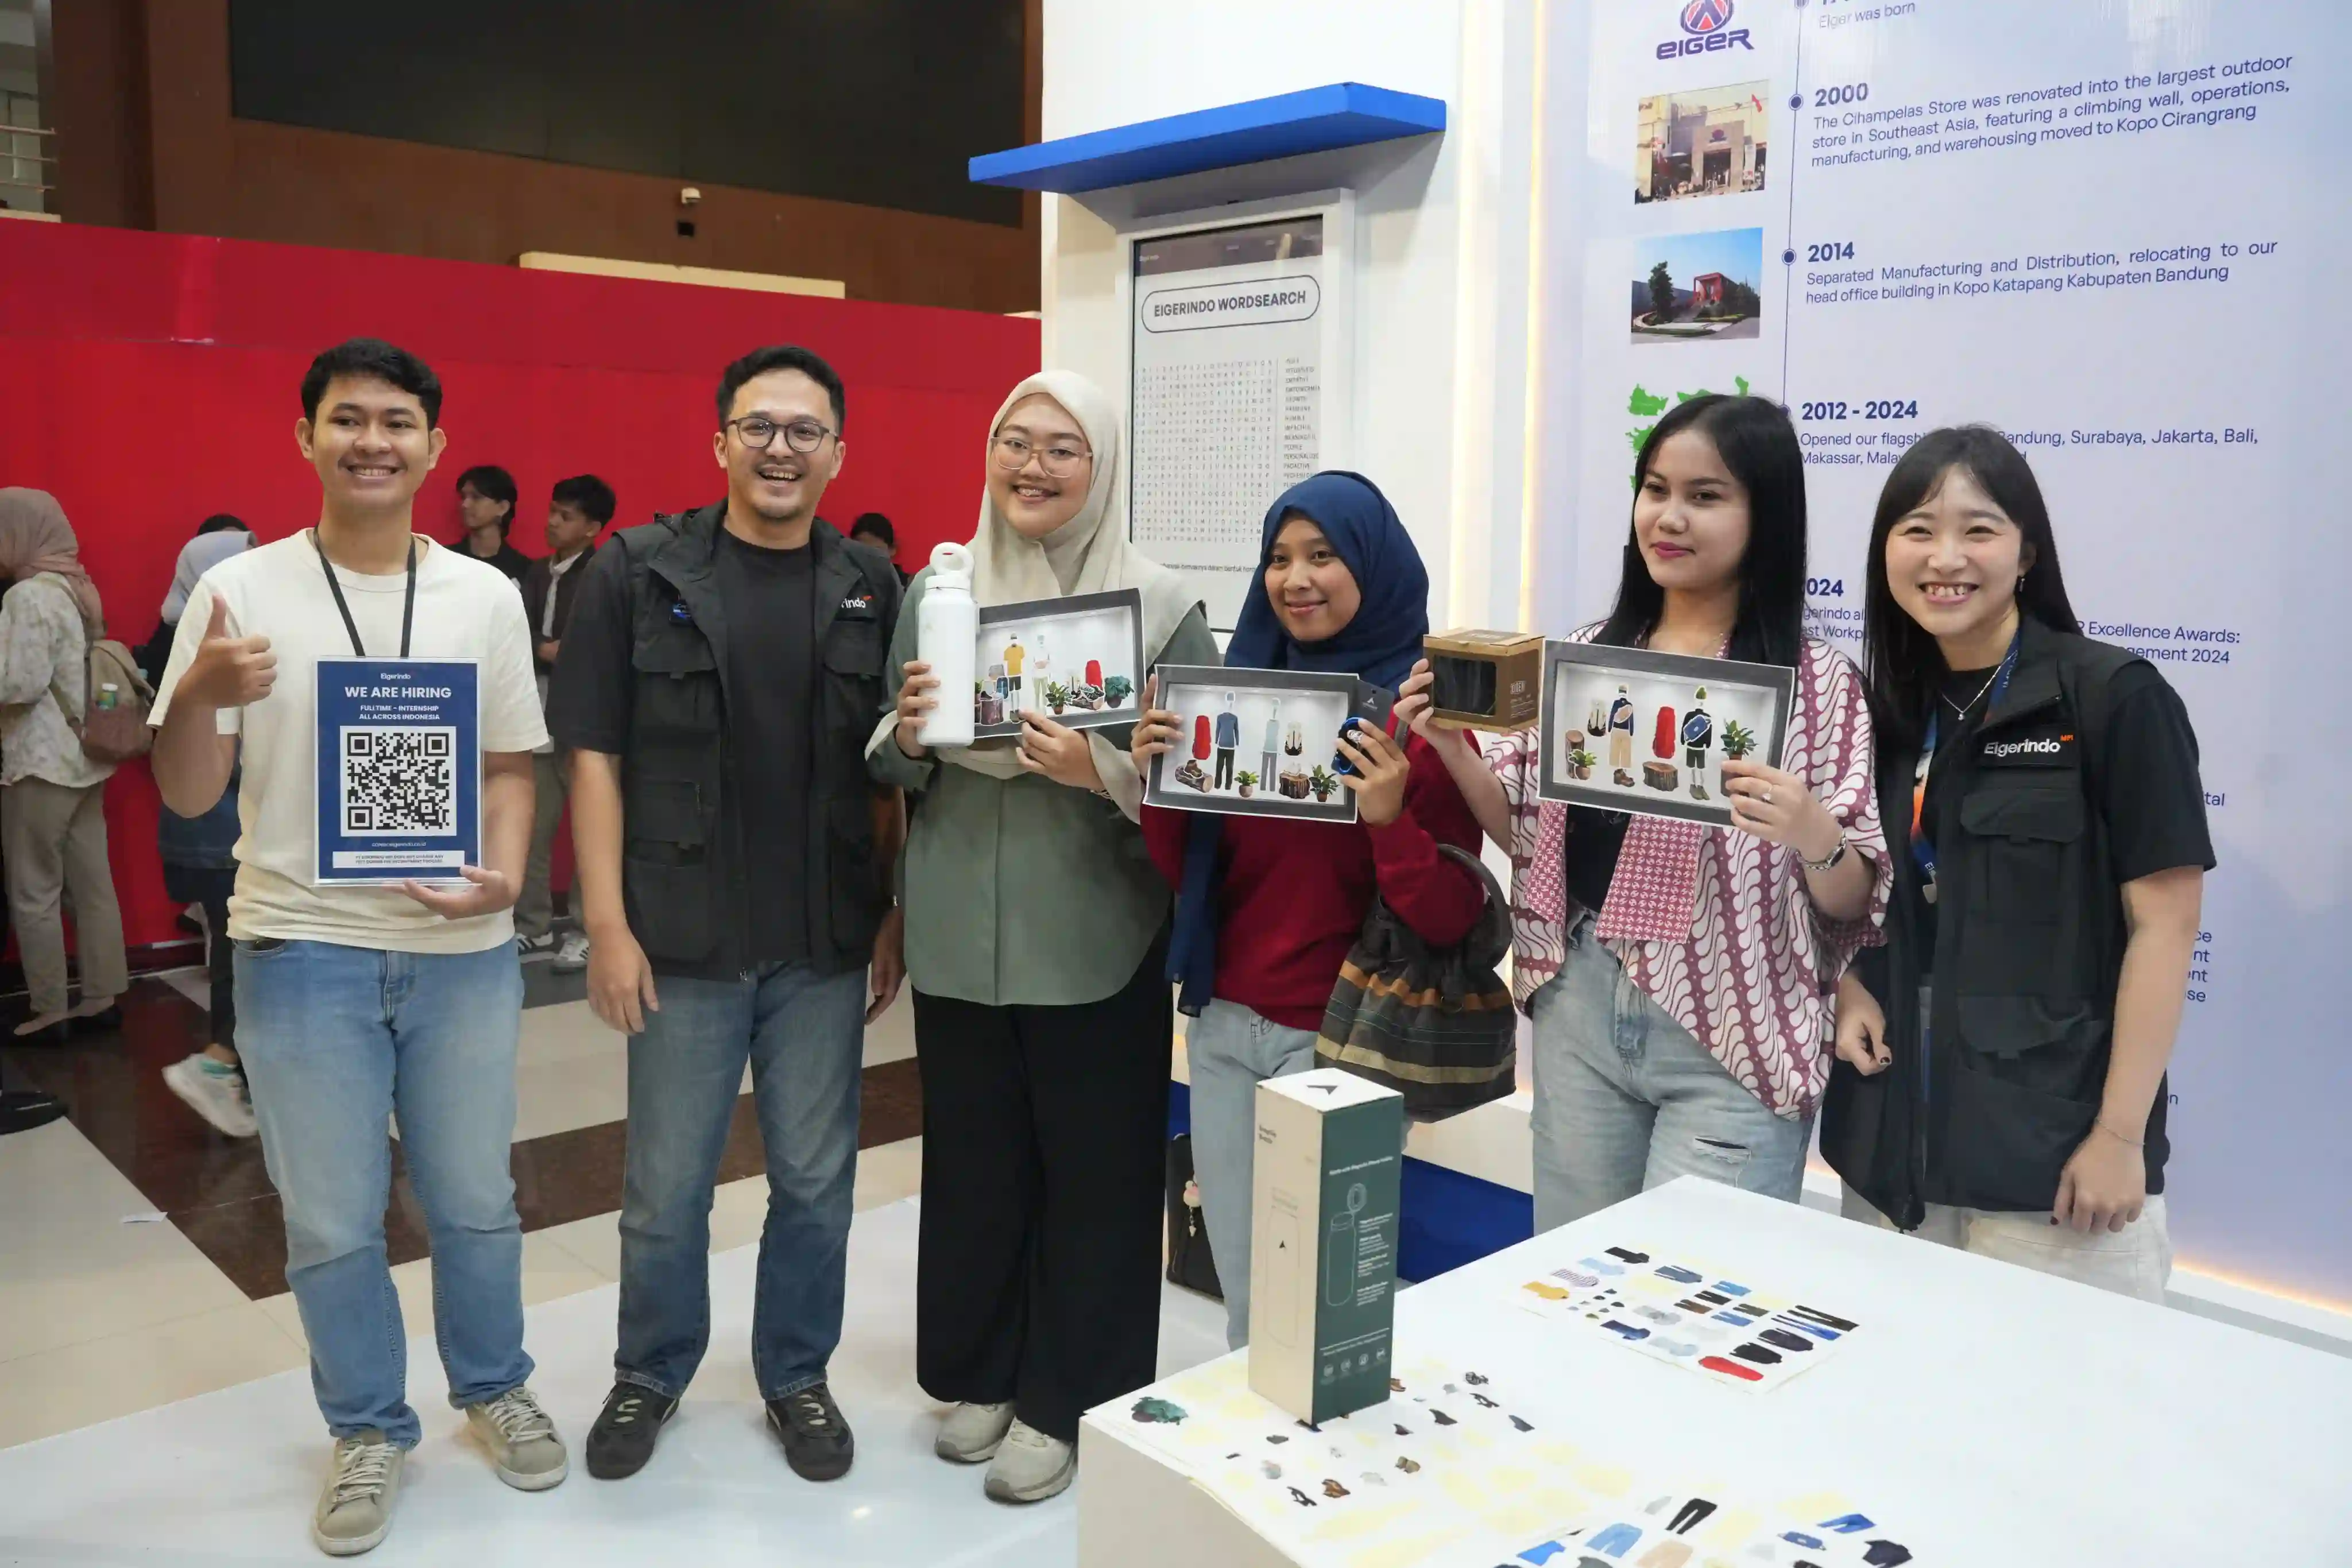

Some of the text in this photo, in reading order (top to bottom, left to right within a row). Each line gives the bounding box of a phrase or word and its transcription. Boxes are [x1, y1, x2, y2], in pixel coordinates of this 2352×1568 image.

[1819, 2, 1916, 29] Eiger was born
[1813, 56, 2293, 131] The Cihampelas Store was renovated into the largest outdoor
[1815, 82, 1869, 107] 2000
[1812, 79, 2291, 149] store in Southeast Asia, featuring a climbing wall, operations,
[1812, 104, 2257, 168] manufacturing, and warehousing moved to Kopo Cirangrang
[1808, 242, 1855, 262] 2014
[1806, 241, 2278, 287] Separated Manufacturing and Distribution, relocating to our
[1806, 266, 2229, 305] head office building in Kopo Katapang Kabupaten Bandung
[1154, 291, 1306, 317] EIGERINDO WORDSEARCH
[1802, 401, 1847, 420] 2012
[1865, 400, 1918, 420] 2024
[1801, 432, 1851, 448] Opened
[1855, 435, 1878, 446] our
[2071, 429, 2146, 447] Surabaya,
[2152, 429, 2218, 446] Jakarta,
[2224, 428, 2258, 444] Bali,
[1802, 451, 1863, 465] Makassar,
[1806, 578, 1844, 597] 024
[2088, 621, 2171, 640] Excellence
[2174, 626, 2241, 644] Awards:
[2191, 649, 2230, 664] 2024
[345, 687, 452, 698] WE ARE HIRING
[1984, 738, 2061, 757] Eigerindo
